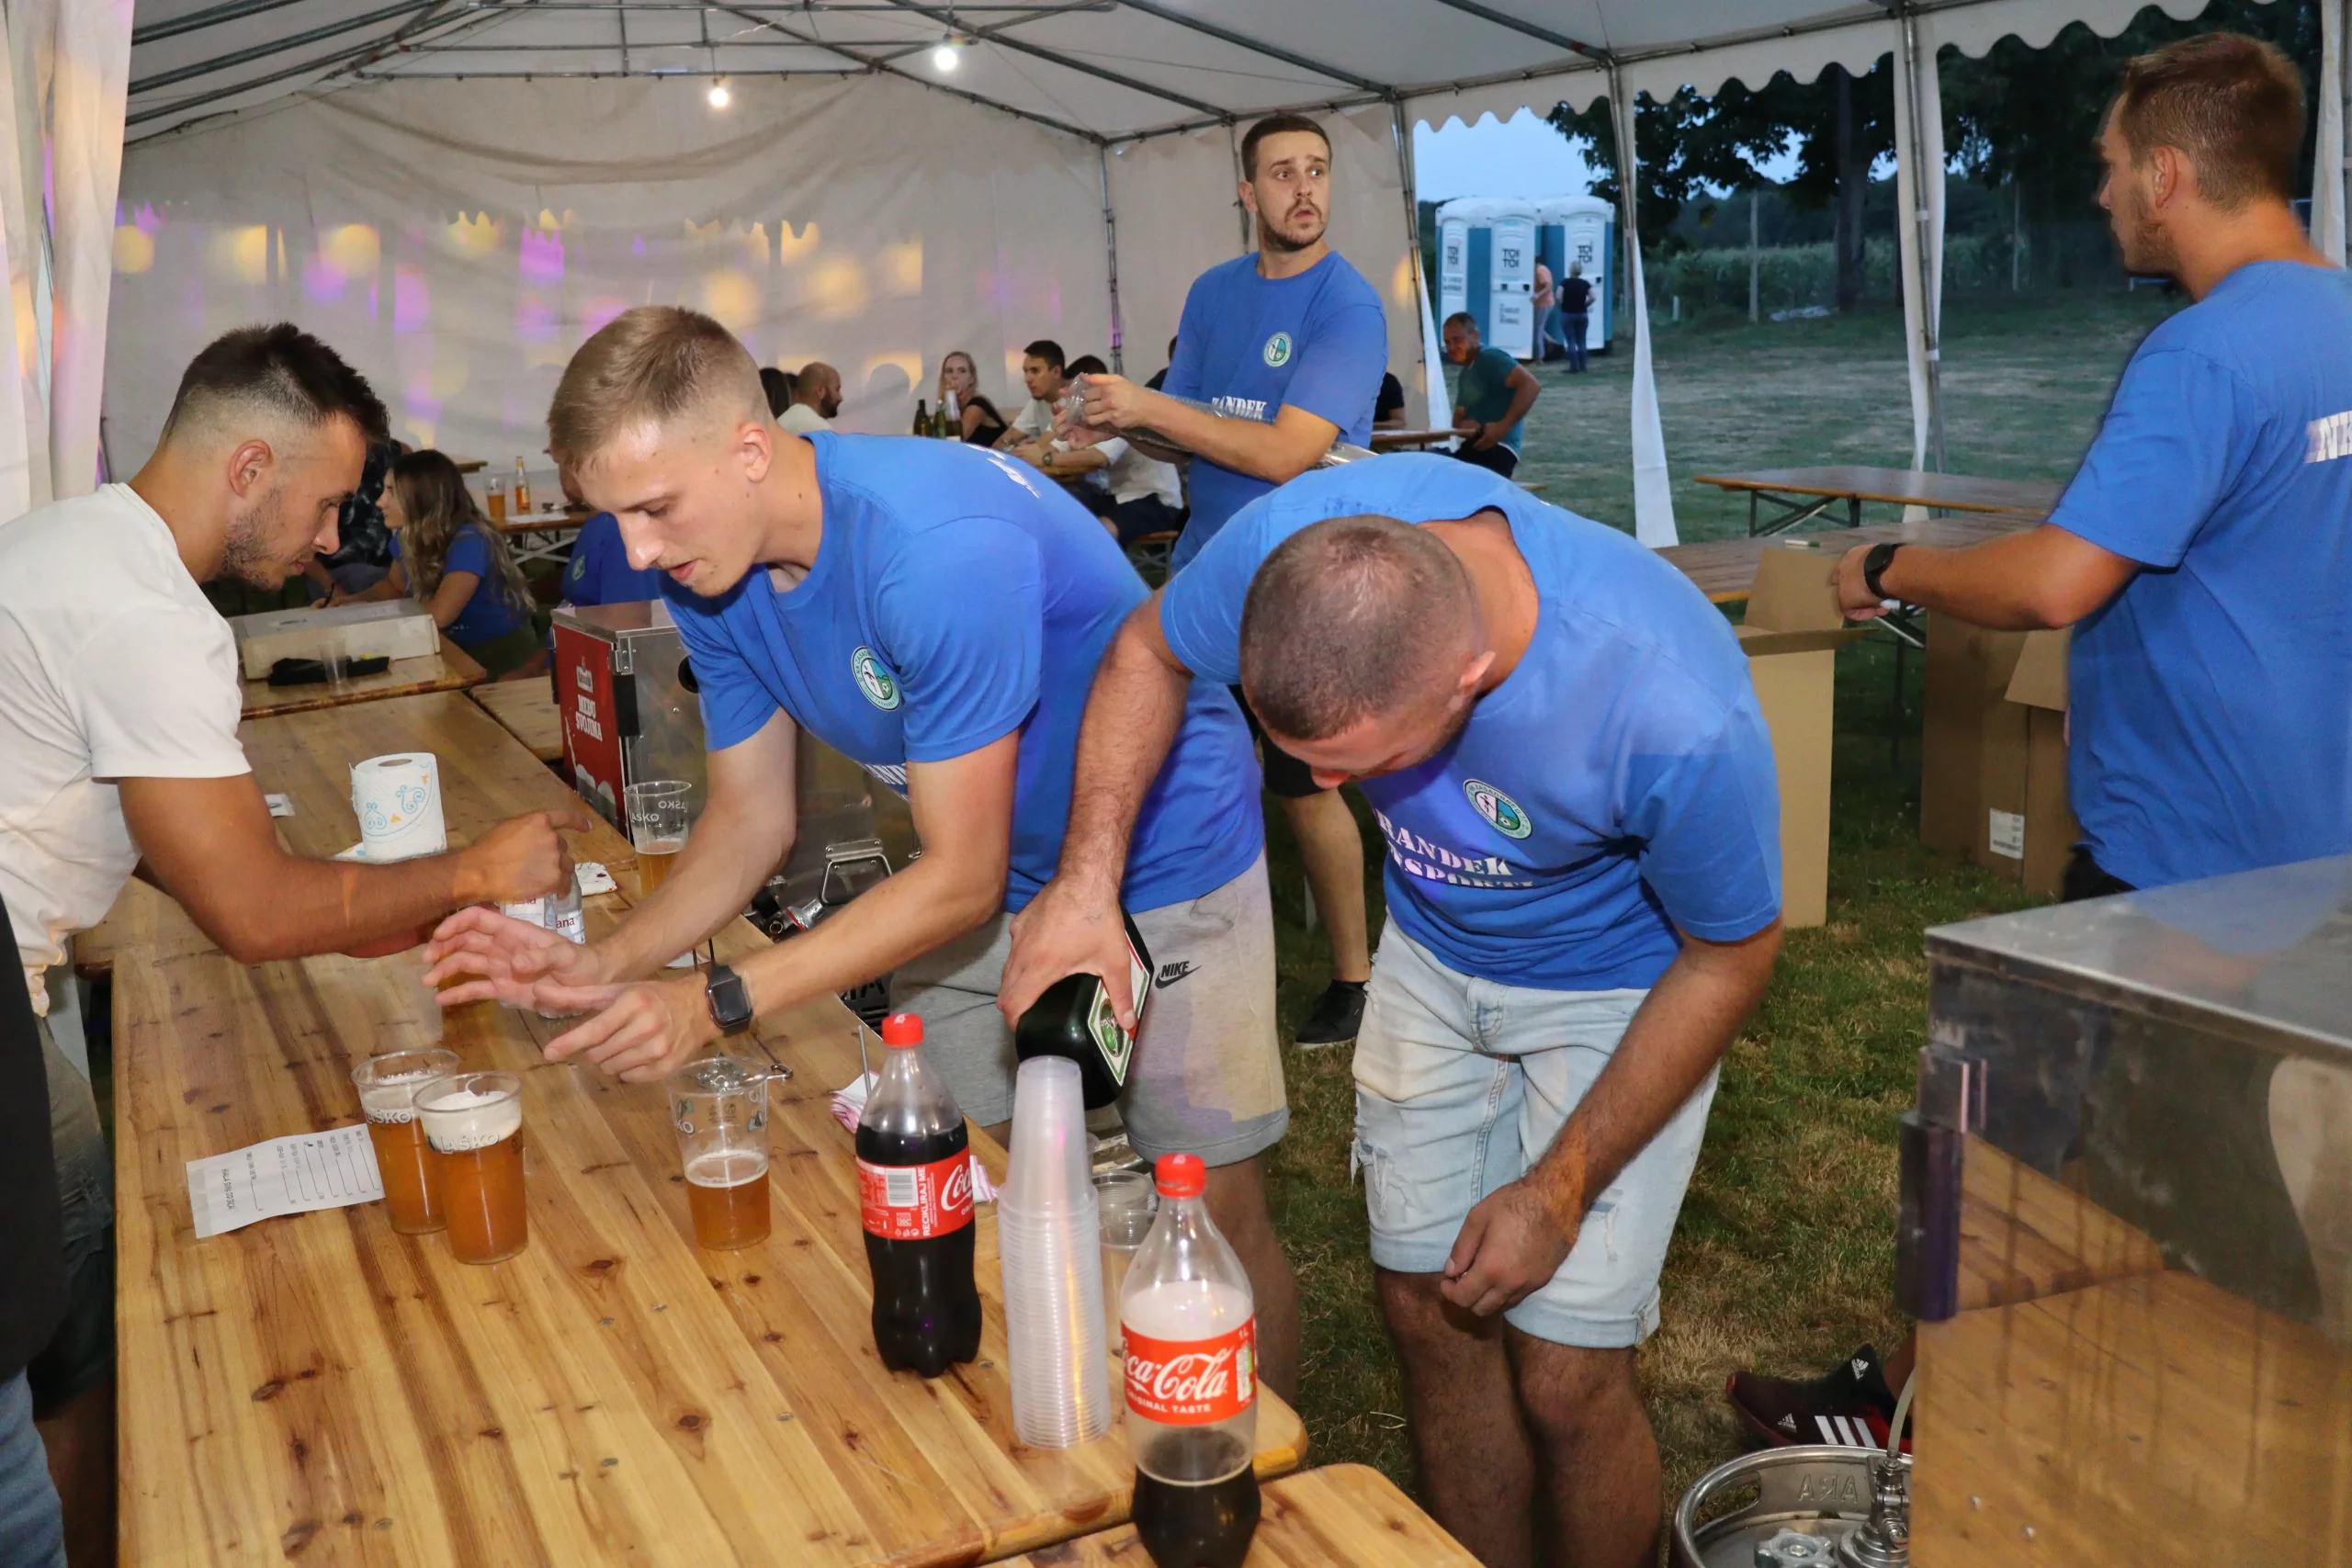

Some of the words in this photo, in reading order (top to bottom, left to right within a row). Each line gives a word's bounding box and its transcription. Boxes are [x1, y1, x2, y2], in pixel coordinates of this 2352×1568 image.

[1447, 246, 1459, 255] TOI
[1502, 248, 1520, 258] TOI
[1577, 245, 1592, 254] TOI
[1447, 256, 1458, 265] TOI
[1502, 258, 1520, 267] TOI
[556, 918, 575, 929] ana
[1160, 961, 1190, 978] NIKE
[918, 1167, 926, 1182] ME
[920, 1183, 931, 1236] RECIKLIRAJ
[1171, 1404, 1212, 1415] TASTE
